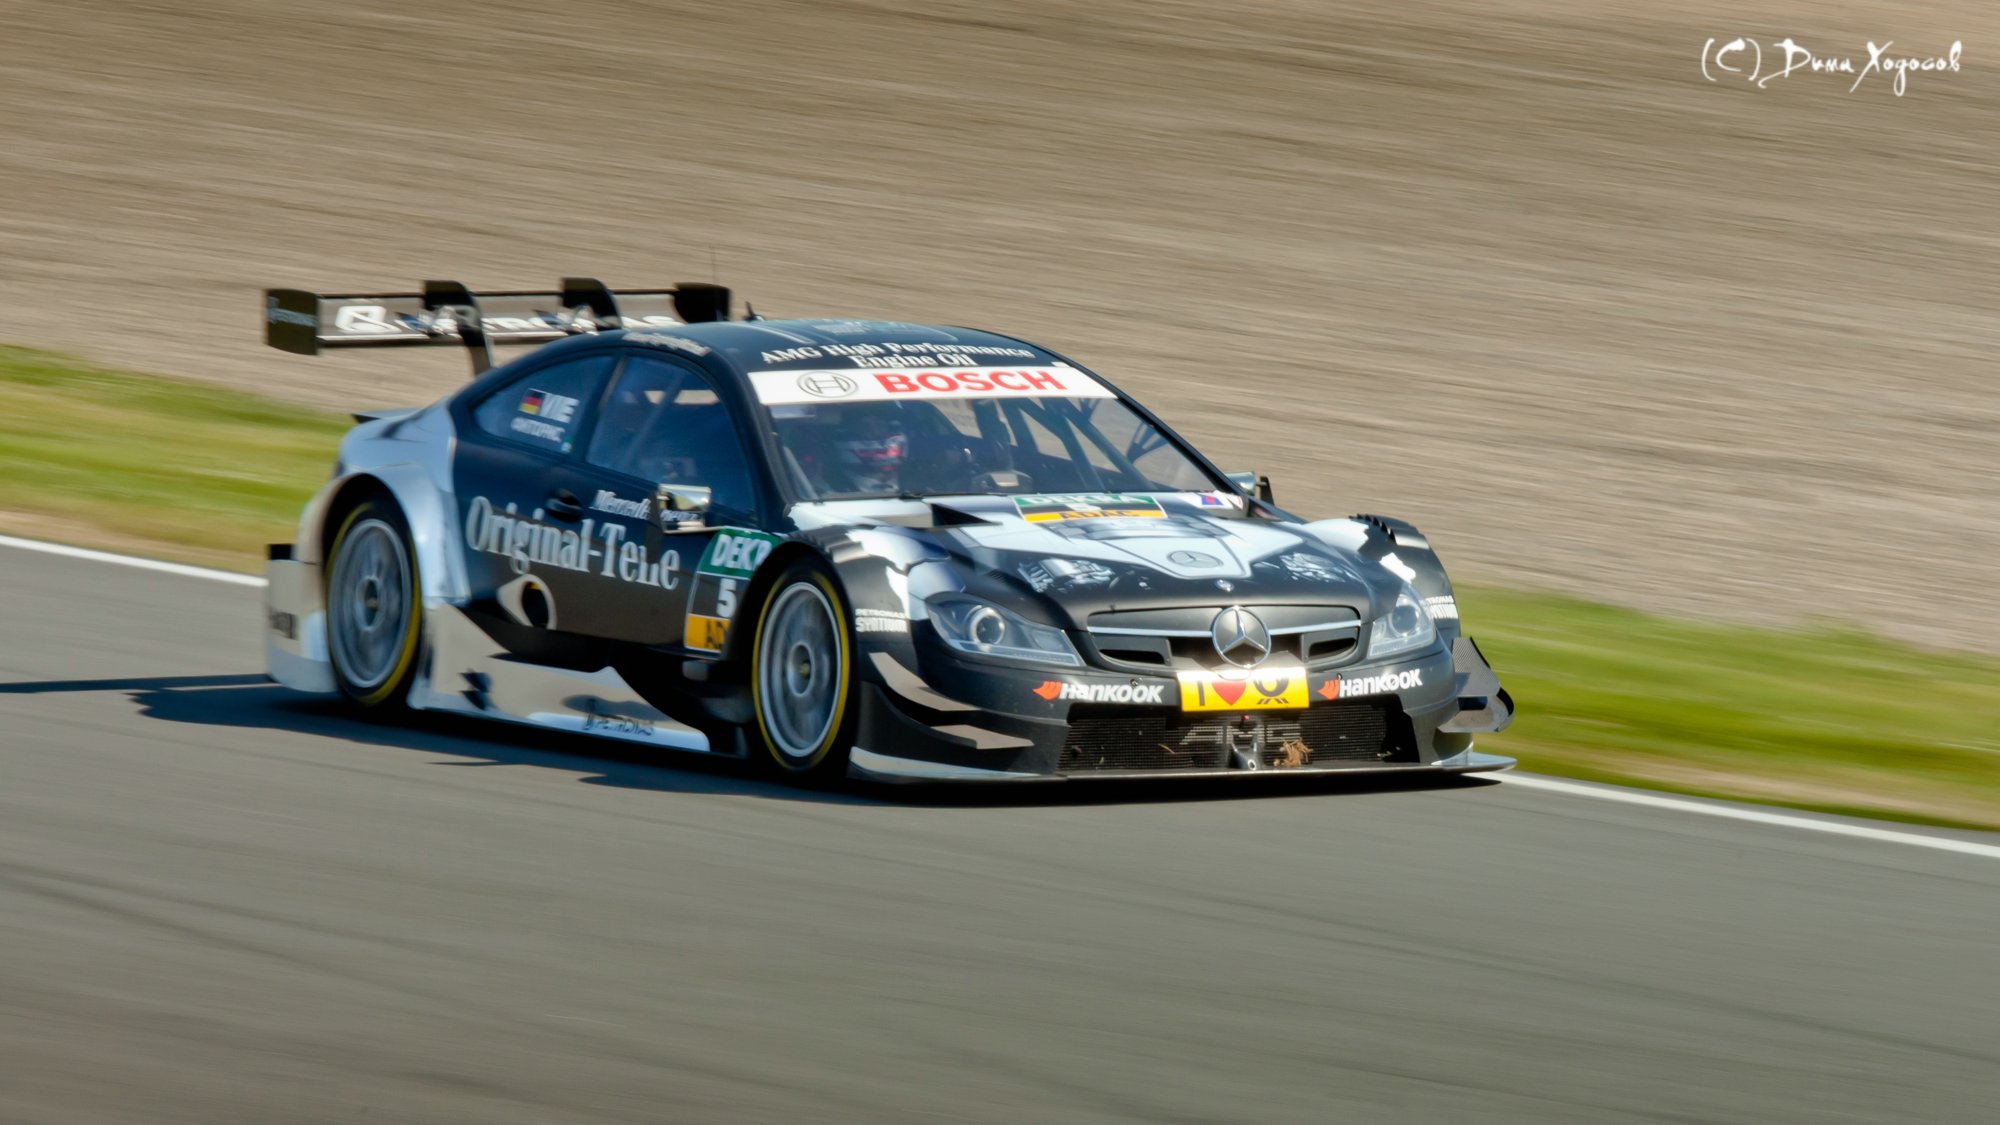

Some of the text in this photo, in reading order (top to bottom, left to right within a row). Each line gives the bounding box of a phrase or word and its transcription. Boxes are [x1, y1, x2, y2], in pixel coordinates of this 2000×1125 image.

[760, 341, 1036, 364] AMG High Performance
[850, 352, 980, 369] Engine Oil
[872, 369, 1068, 394] BOSCH
[716, 578, 738, 618] 5
